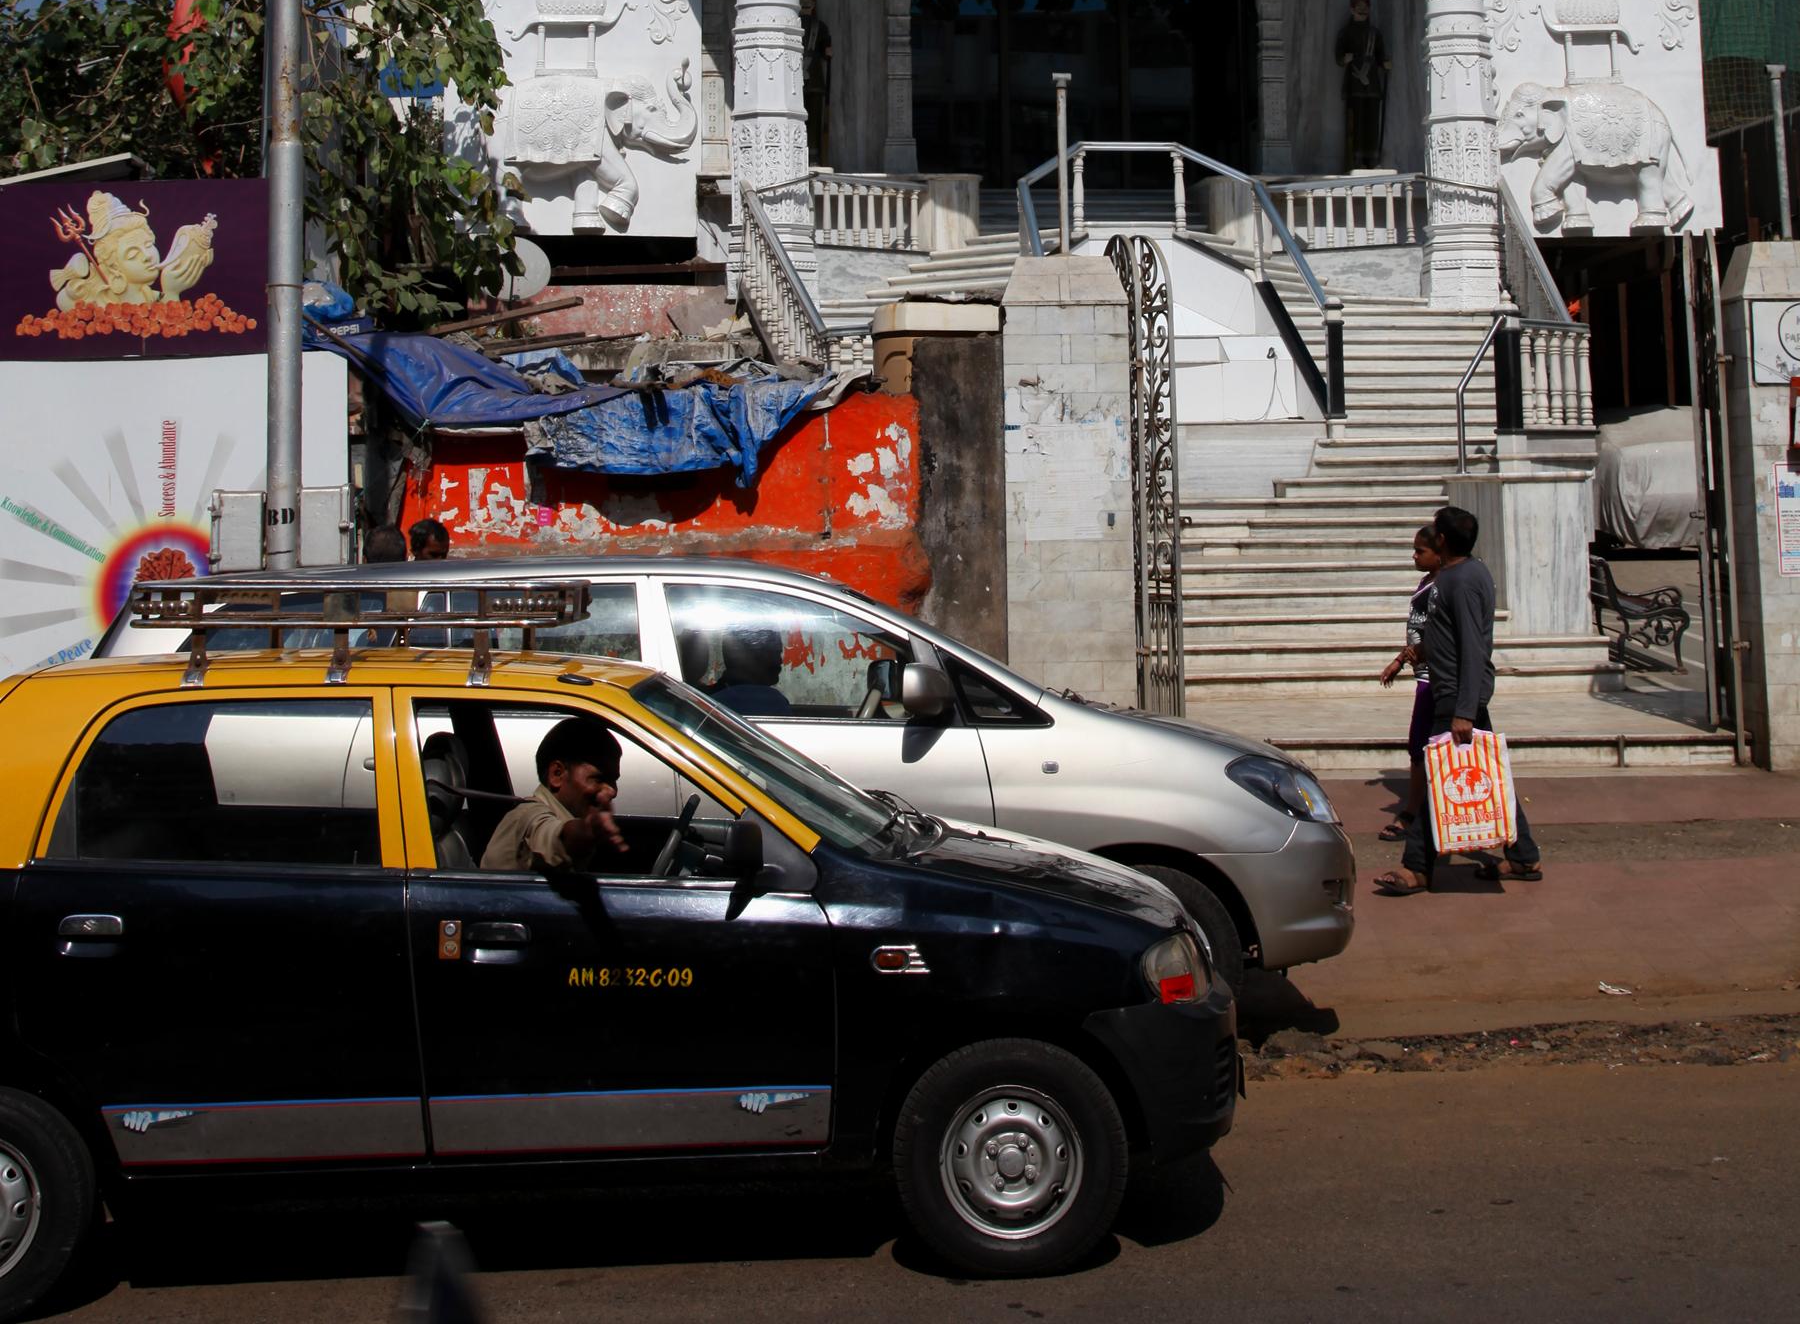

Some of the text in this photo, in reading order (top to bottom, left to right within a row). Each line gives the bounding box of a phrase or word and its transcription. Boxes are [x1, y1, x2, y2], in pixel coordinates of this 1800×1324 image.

[330, 324, 359, 335] PEPSI
[158, 420, 176, 518] Success & Abundance
[0, 496, 41, 526] Knowledge
[49, 524, 106, 563] Communication
[57, 638, 93, 663] Peace
[1441, 812, 1473, 825] Dream
